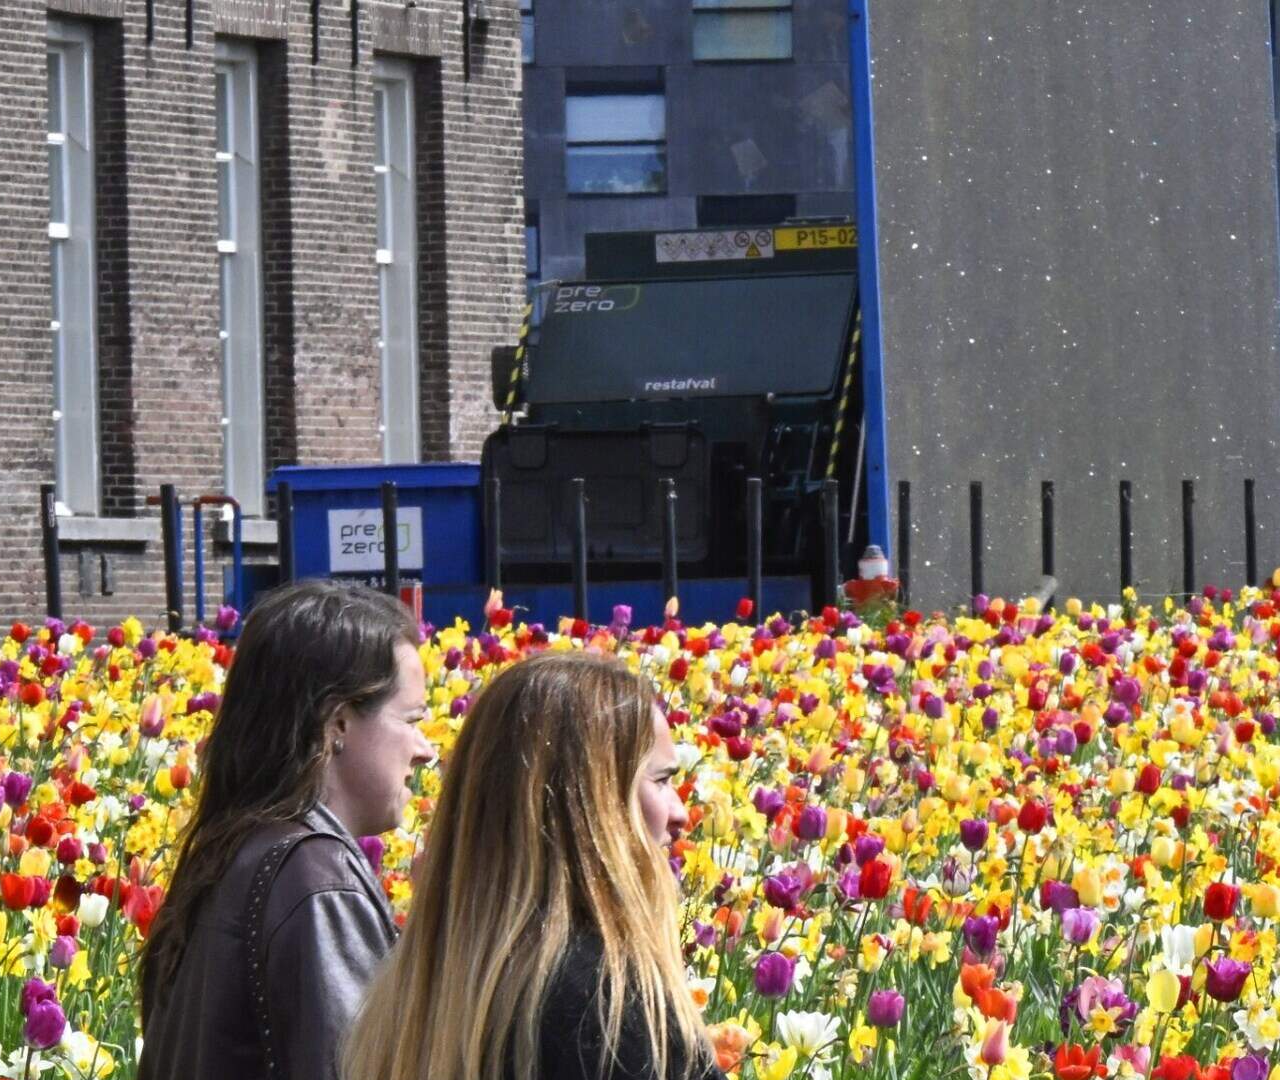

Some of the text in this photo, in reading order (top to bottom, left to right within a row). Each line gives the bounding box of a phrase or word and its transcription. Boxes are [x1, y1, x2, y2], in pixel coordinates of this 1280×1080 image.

[556, 286, 601, 300] pre
[554, 300, 615, 313] zero
[644, 377, 716, 391] restafval
[341, 524, 377, 541] pre
